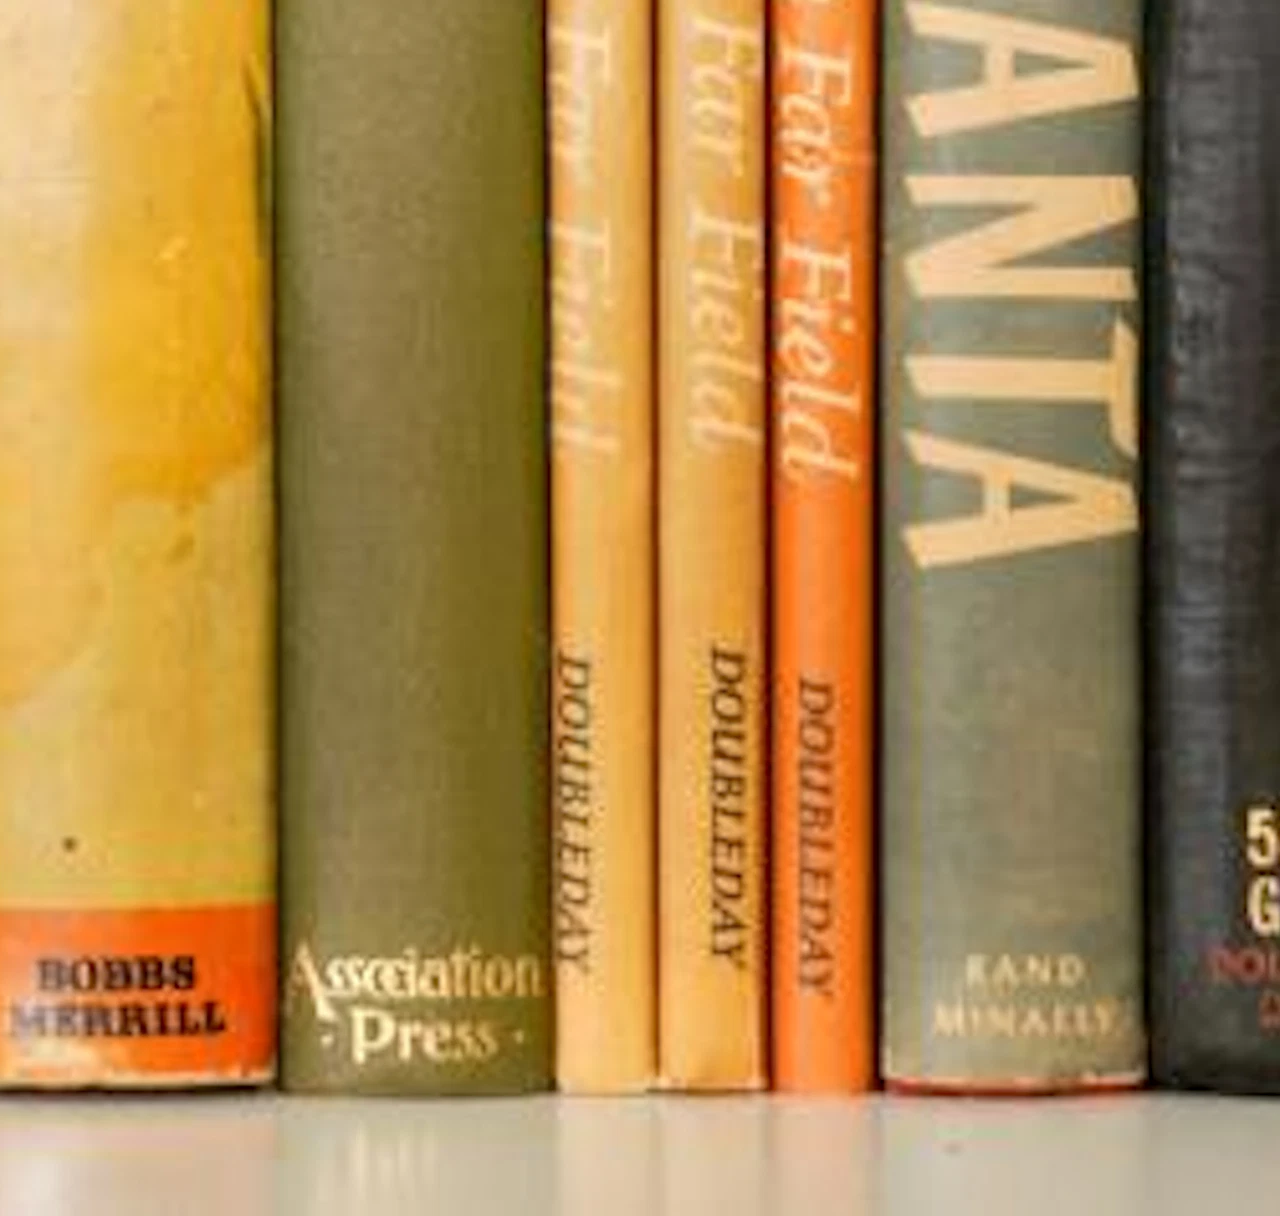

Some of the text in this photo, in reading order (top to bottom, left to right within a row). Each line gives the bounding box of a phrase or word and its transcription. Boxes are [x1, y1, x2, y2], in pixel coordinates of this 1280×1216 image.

[548, 24, 612, 174] Far
[687, 12, 765, 178] Far
[780, 39, 854, 206] Far
[548, 218, 623, 456] Field
[687, 202, 762, 451] Field
[780, 236, 862, 482] Field
[556, 646, 592, 978] DOUBLEDAY
[711, 646, 747, 971] DOUBLEDAY
[799, 677, 836, 1001] DOUBLEDAY
[10, 998, 226, 1038] MERRILL
[36, 954, 195, 991] BOBBS
[288, 941, 544, 1020] Association
[350, 1006, 500, 1062] Press
[967, 953, 1086, 986] RAND
